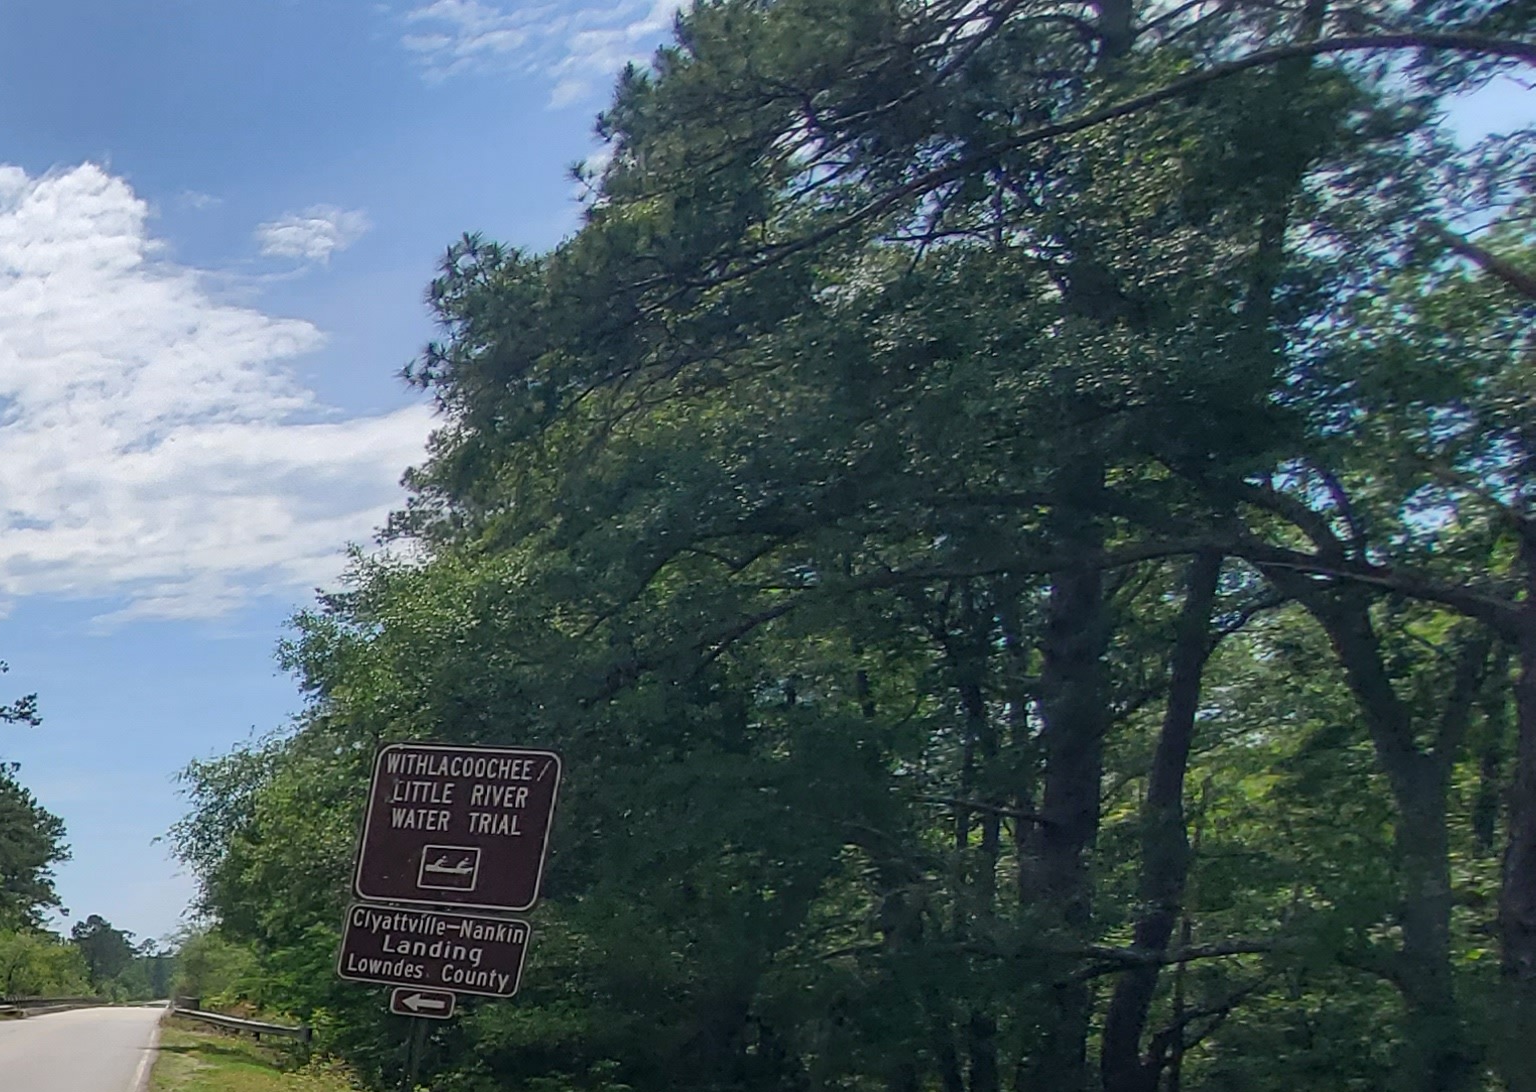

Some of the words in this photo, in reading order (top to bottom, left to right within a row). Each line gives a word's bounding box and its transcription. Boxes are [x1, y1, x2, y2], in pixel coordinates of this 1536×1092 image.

[393, 782, 455, 804] LITTLE
[471, 784, 528, 808] RIVER
[391, 808, 451, 831] WATER
[469, 812, 521, 836] TRIAL
[383, 935, 483, 965] Landing
[348, 953, 424, 979] Lowndes
[442, 964, 509, 992] County
